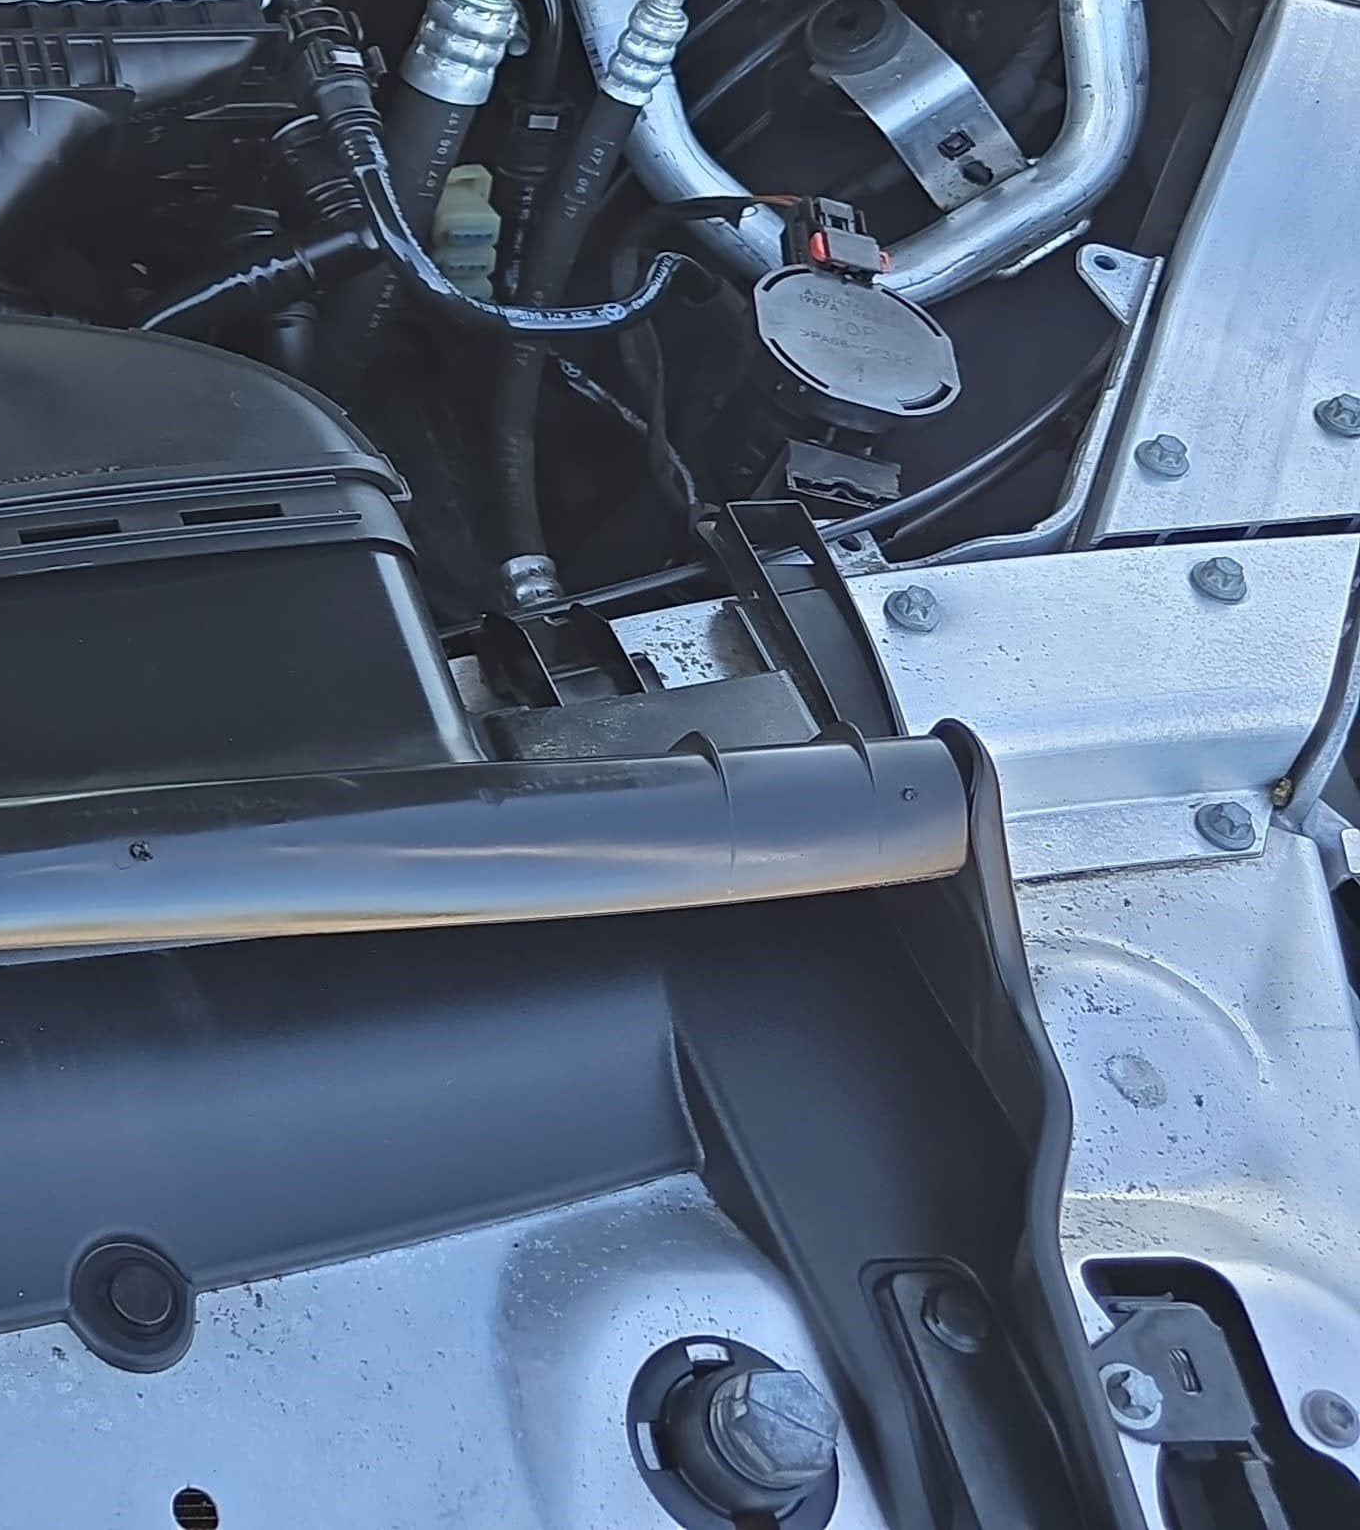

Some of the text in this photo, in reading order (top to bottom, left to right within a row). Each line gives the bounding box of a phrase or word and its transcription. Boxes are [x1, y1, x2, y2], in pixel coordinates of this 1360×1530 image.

[589, 148, 605, 165] 07
[426, 171, 438, 187] 07
[832, 317, 879, 337] TOP
